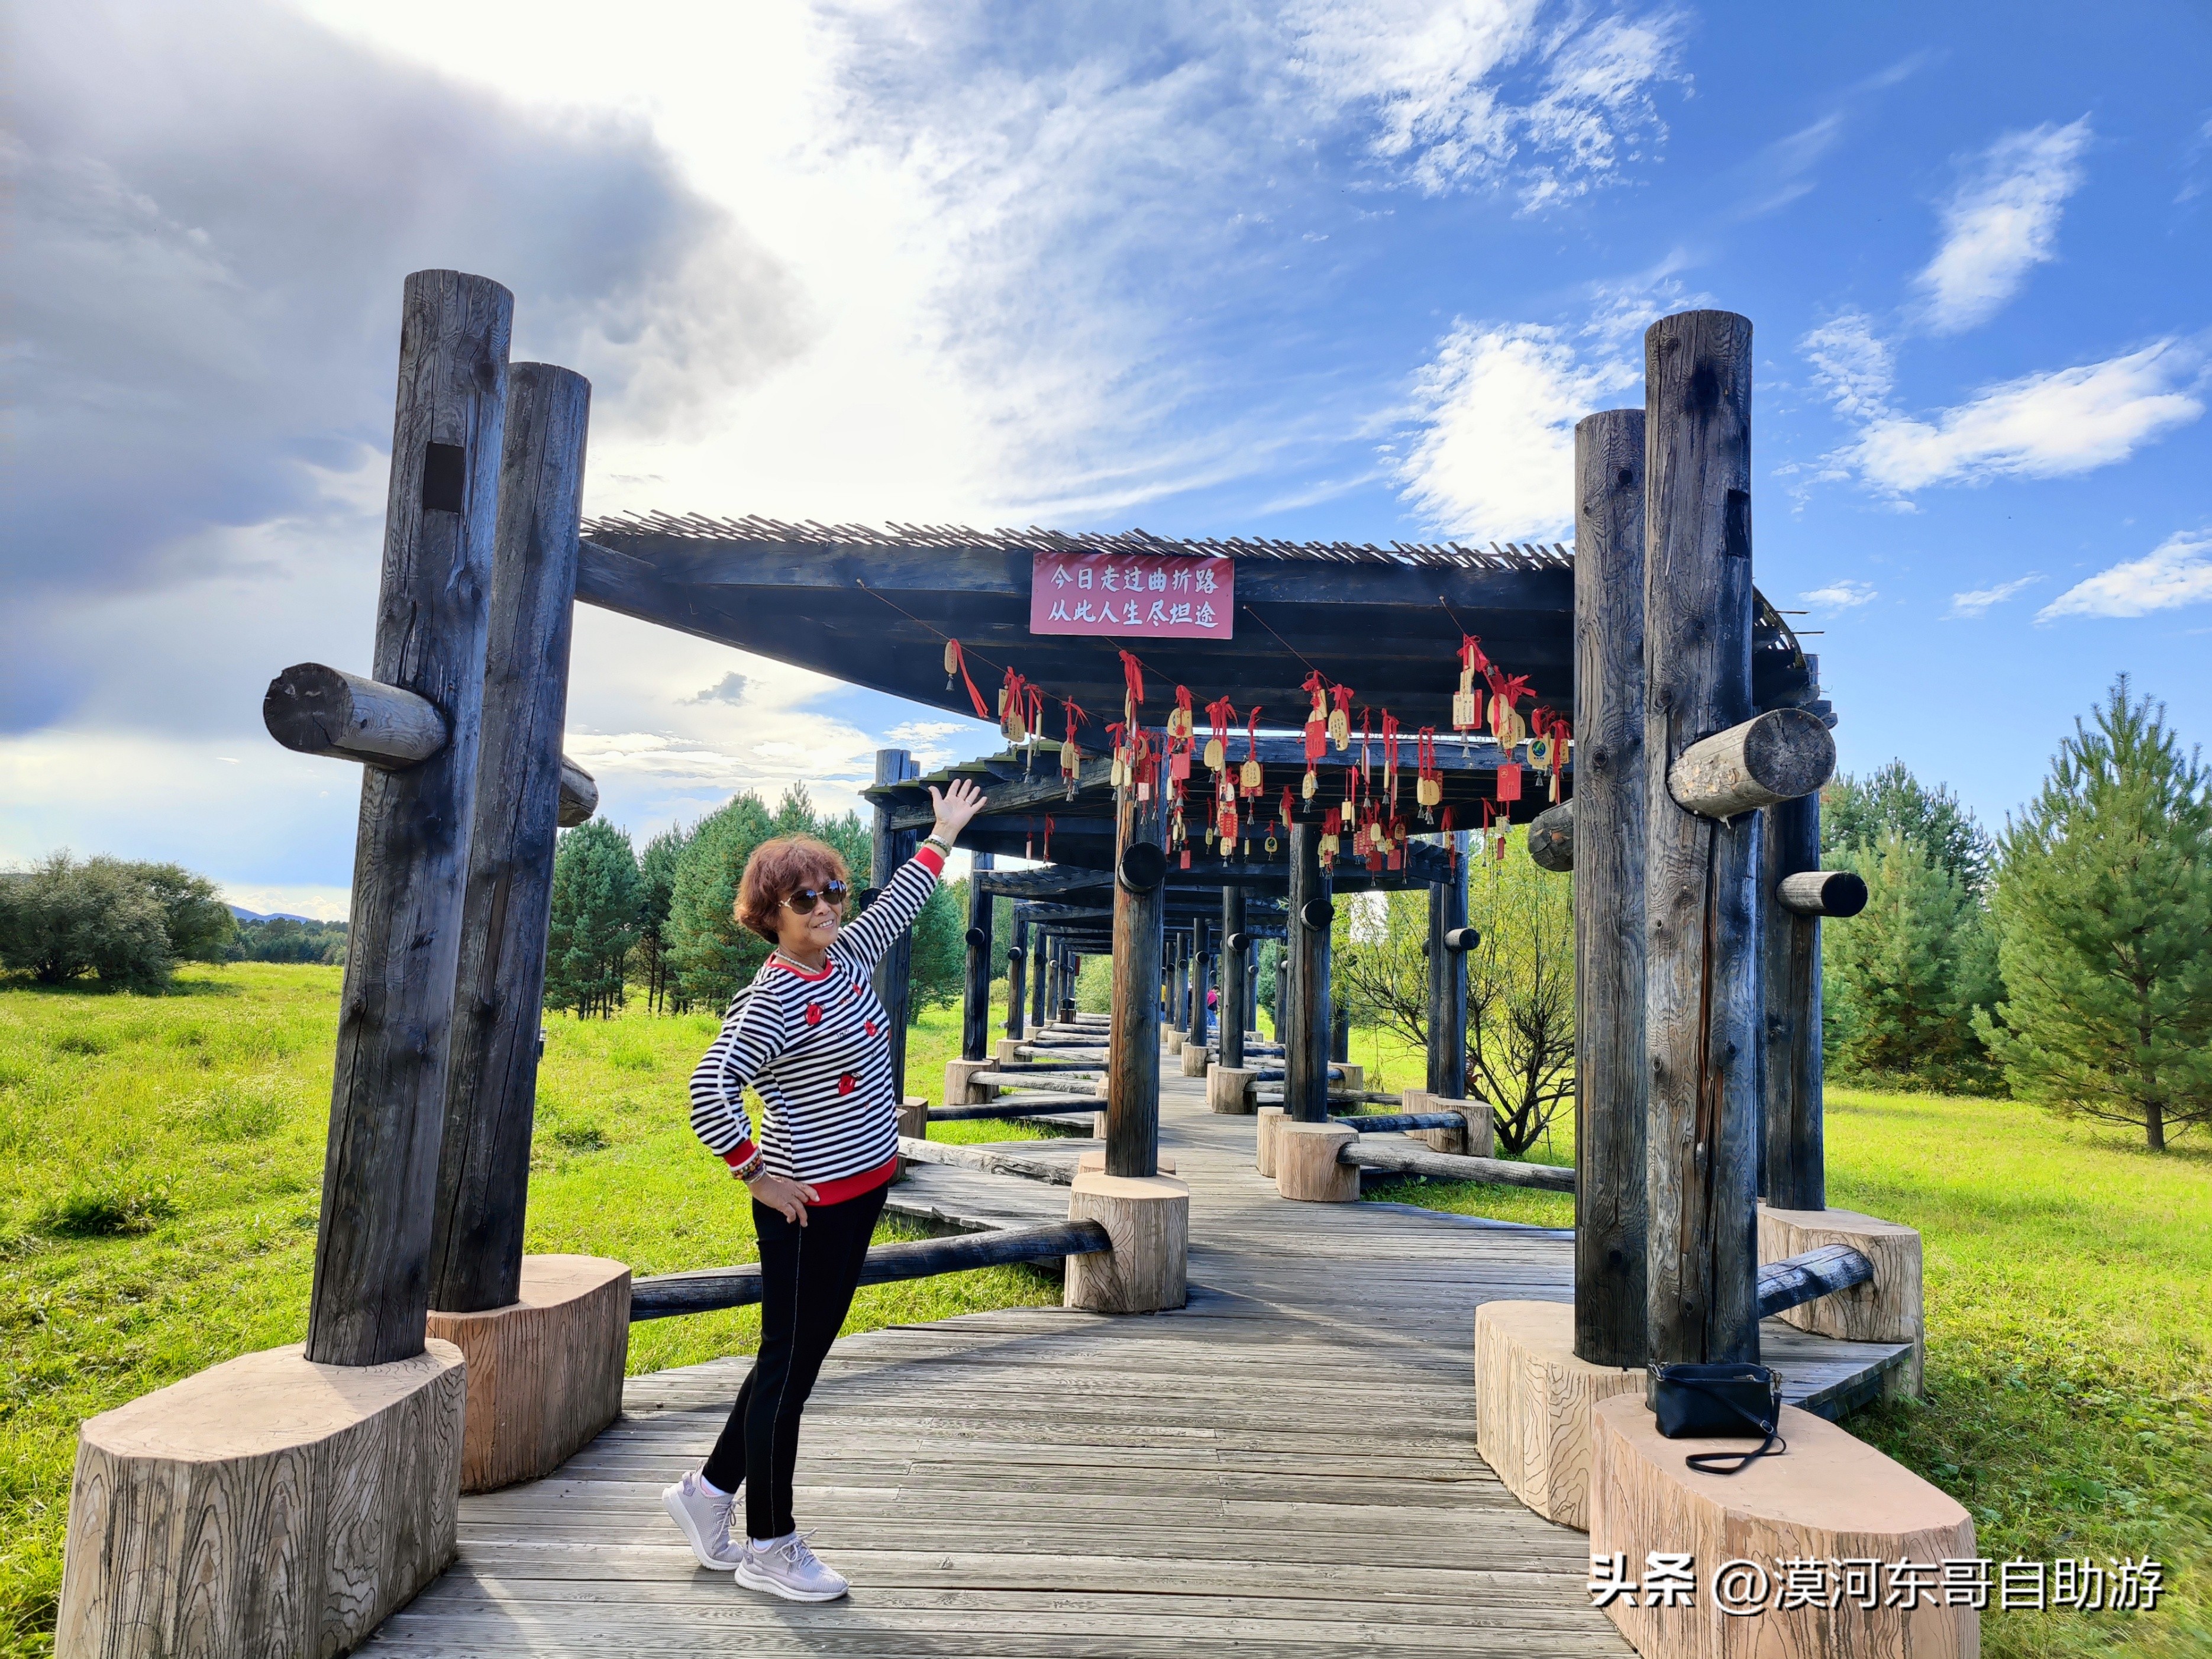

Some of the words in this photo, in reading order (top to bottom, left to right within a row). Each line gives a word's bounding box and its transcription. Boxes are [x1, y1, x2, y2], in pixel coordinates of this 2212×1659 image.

[1050, 564, 1219, 595] 今日走过曲折路
[1048, 599, 1219, 628] 从此人生尽坦途
